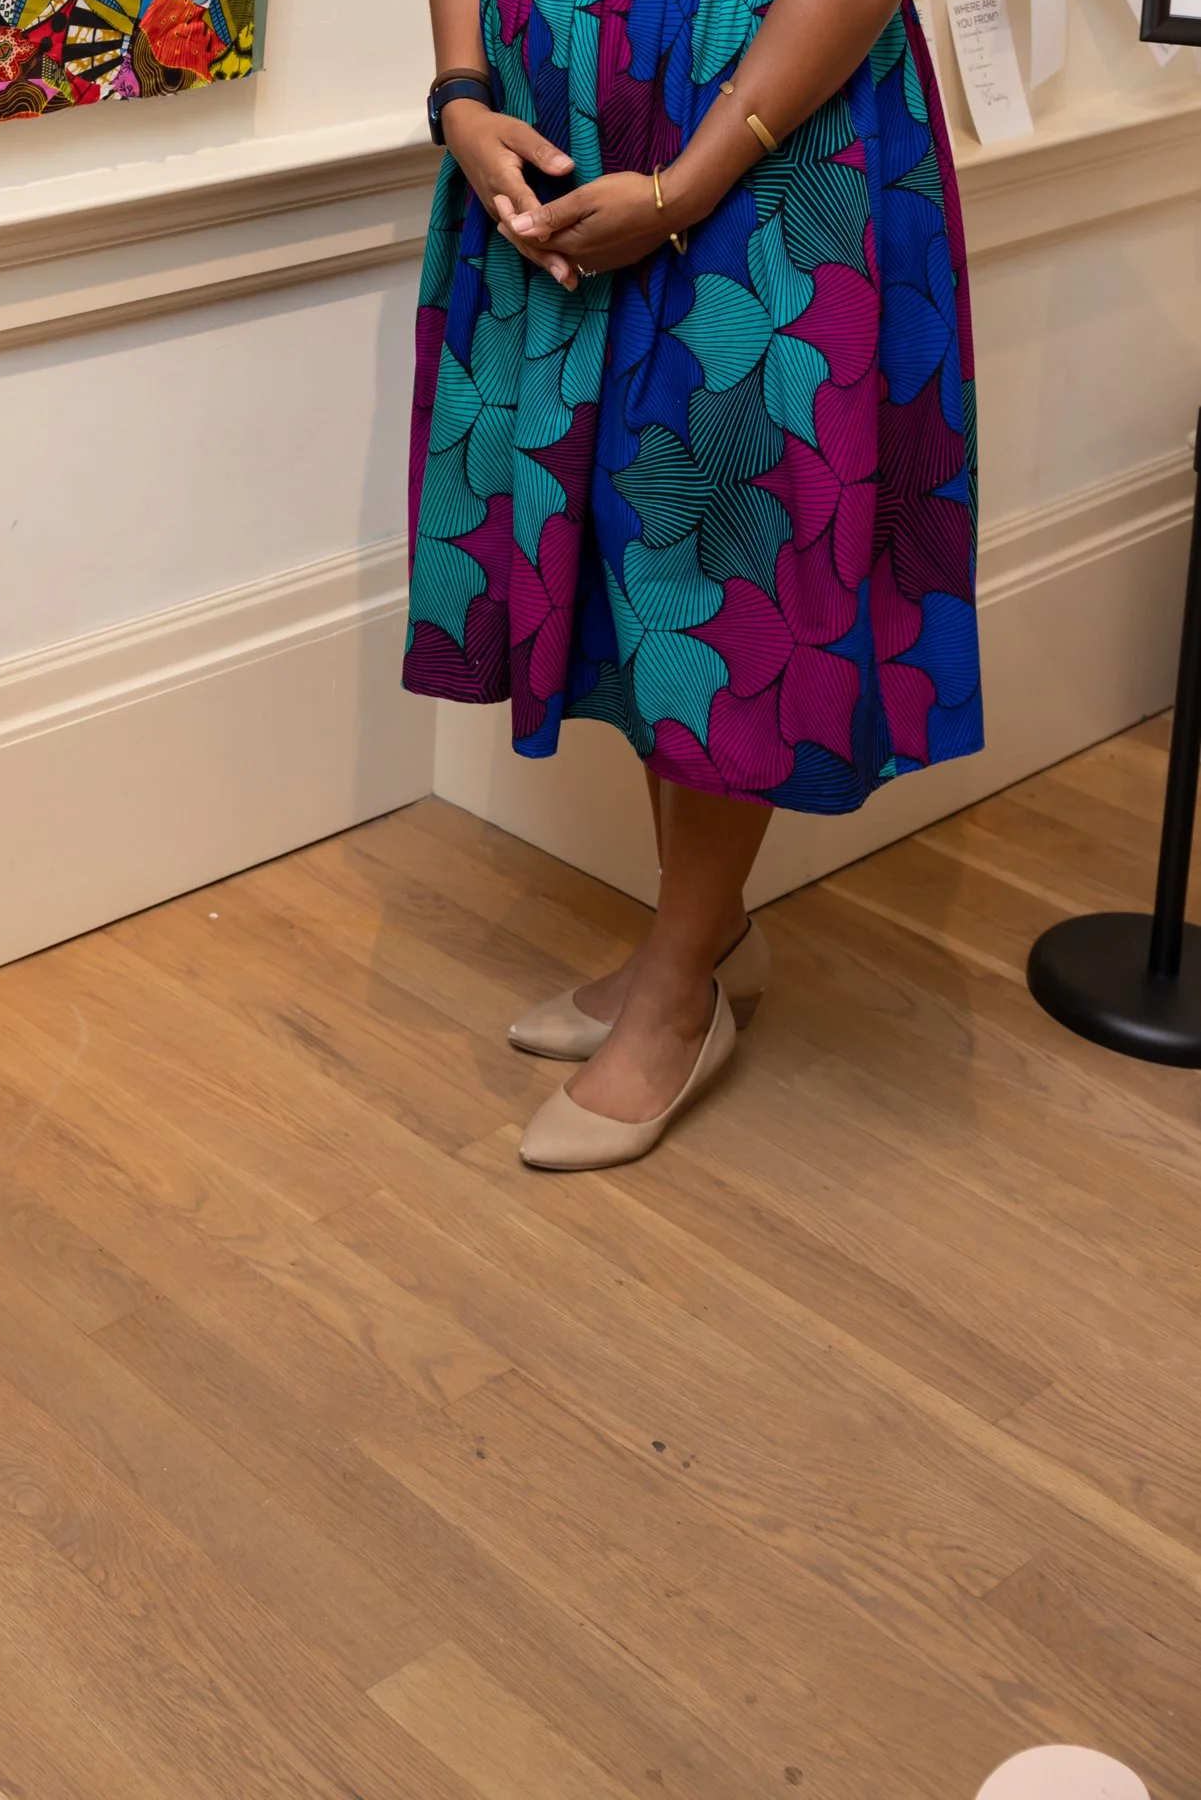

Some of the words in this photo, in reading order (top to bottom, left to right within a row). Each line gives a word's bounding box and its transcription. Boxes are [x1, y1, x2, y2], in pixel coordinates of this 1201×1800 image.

[953, 0, 981, 16] WHERE
[956, 17, 973, 29] YOU
[973, 11, 999, 25] FROM?
